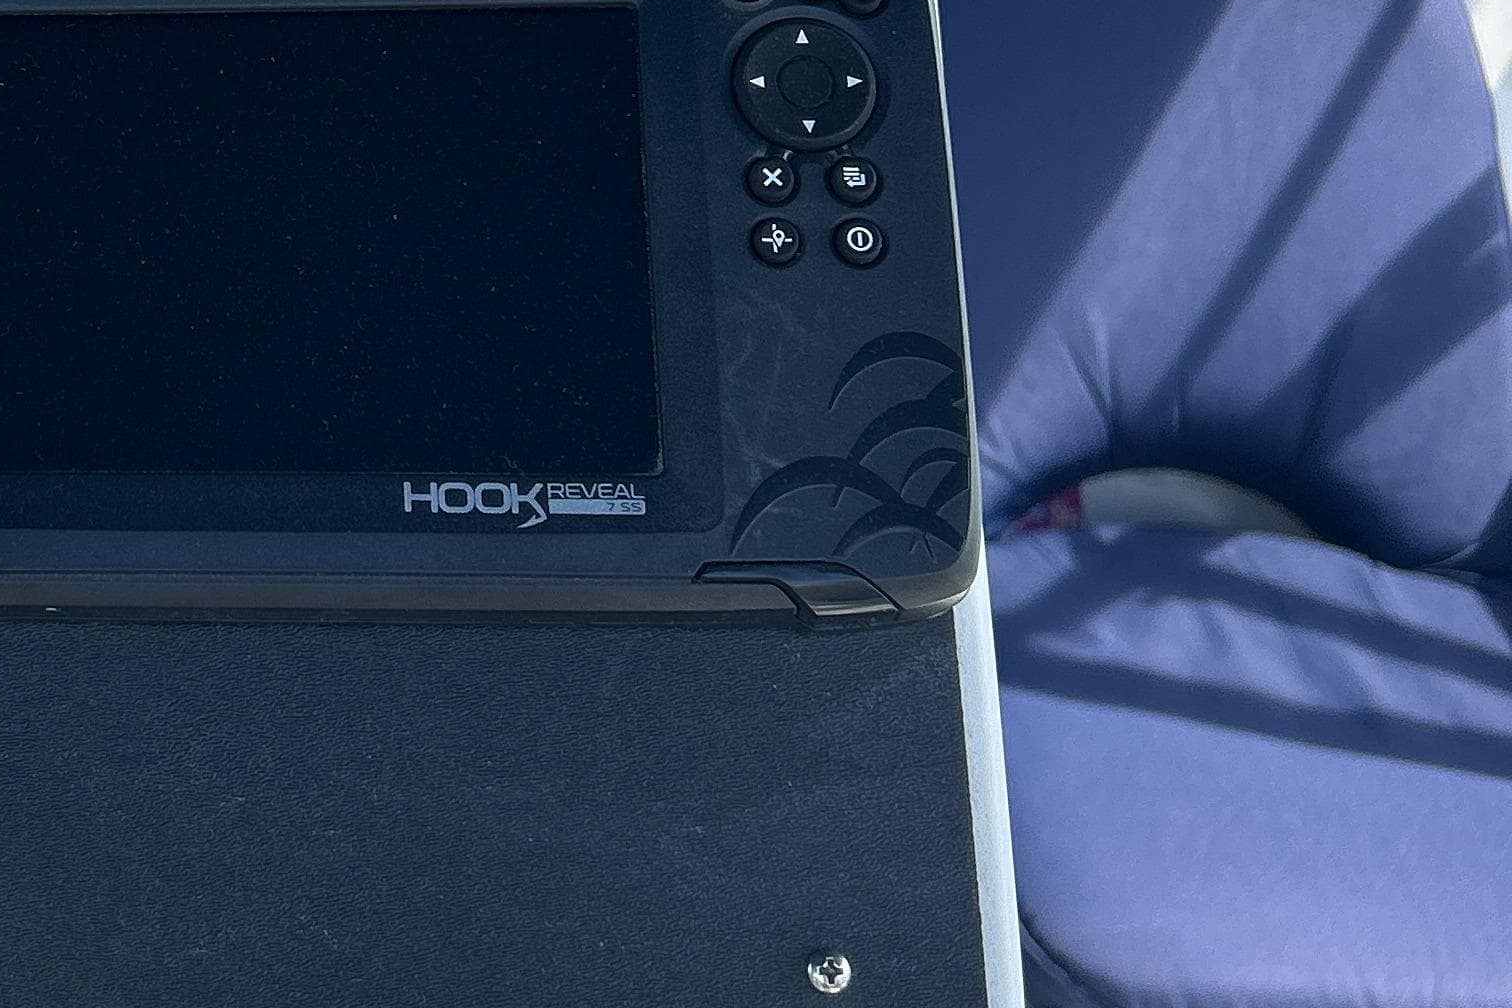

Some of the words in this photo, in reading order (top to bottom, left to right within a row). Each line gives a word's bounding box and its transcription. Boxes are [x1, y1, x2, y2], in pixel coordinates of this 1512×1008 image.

[402, 481, 548, 529] HOOK
[547, 482, 646, 499] REVEAL
[606, 501, 616, 512] 7
[620, 501, 643, 513] SS
